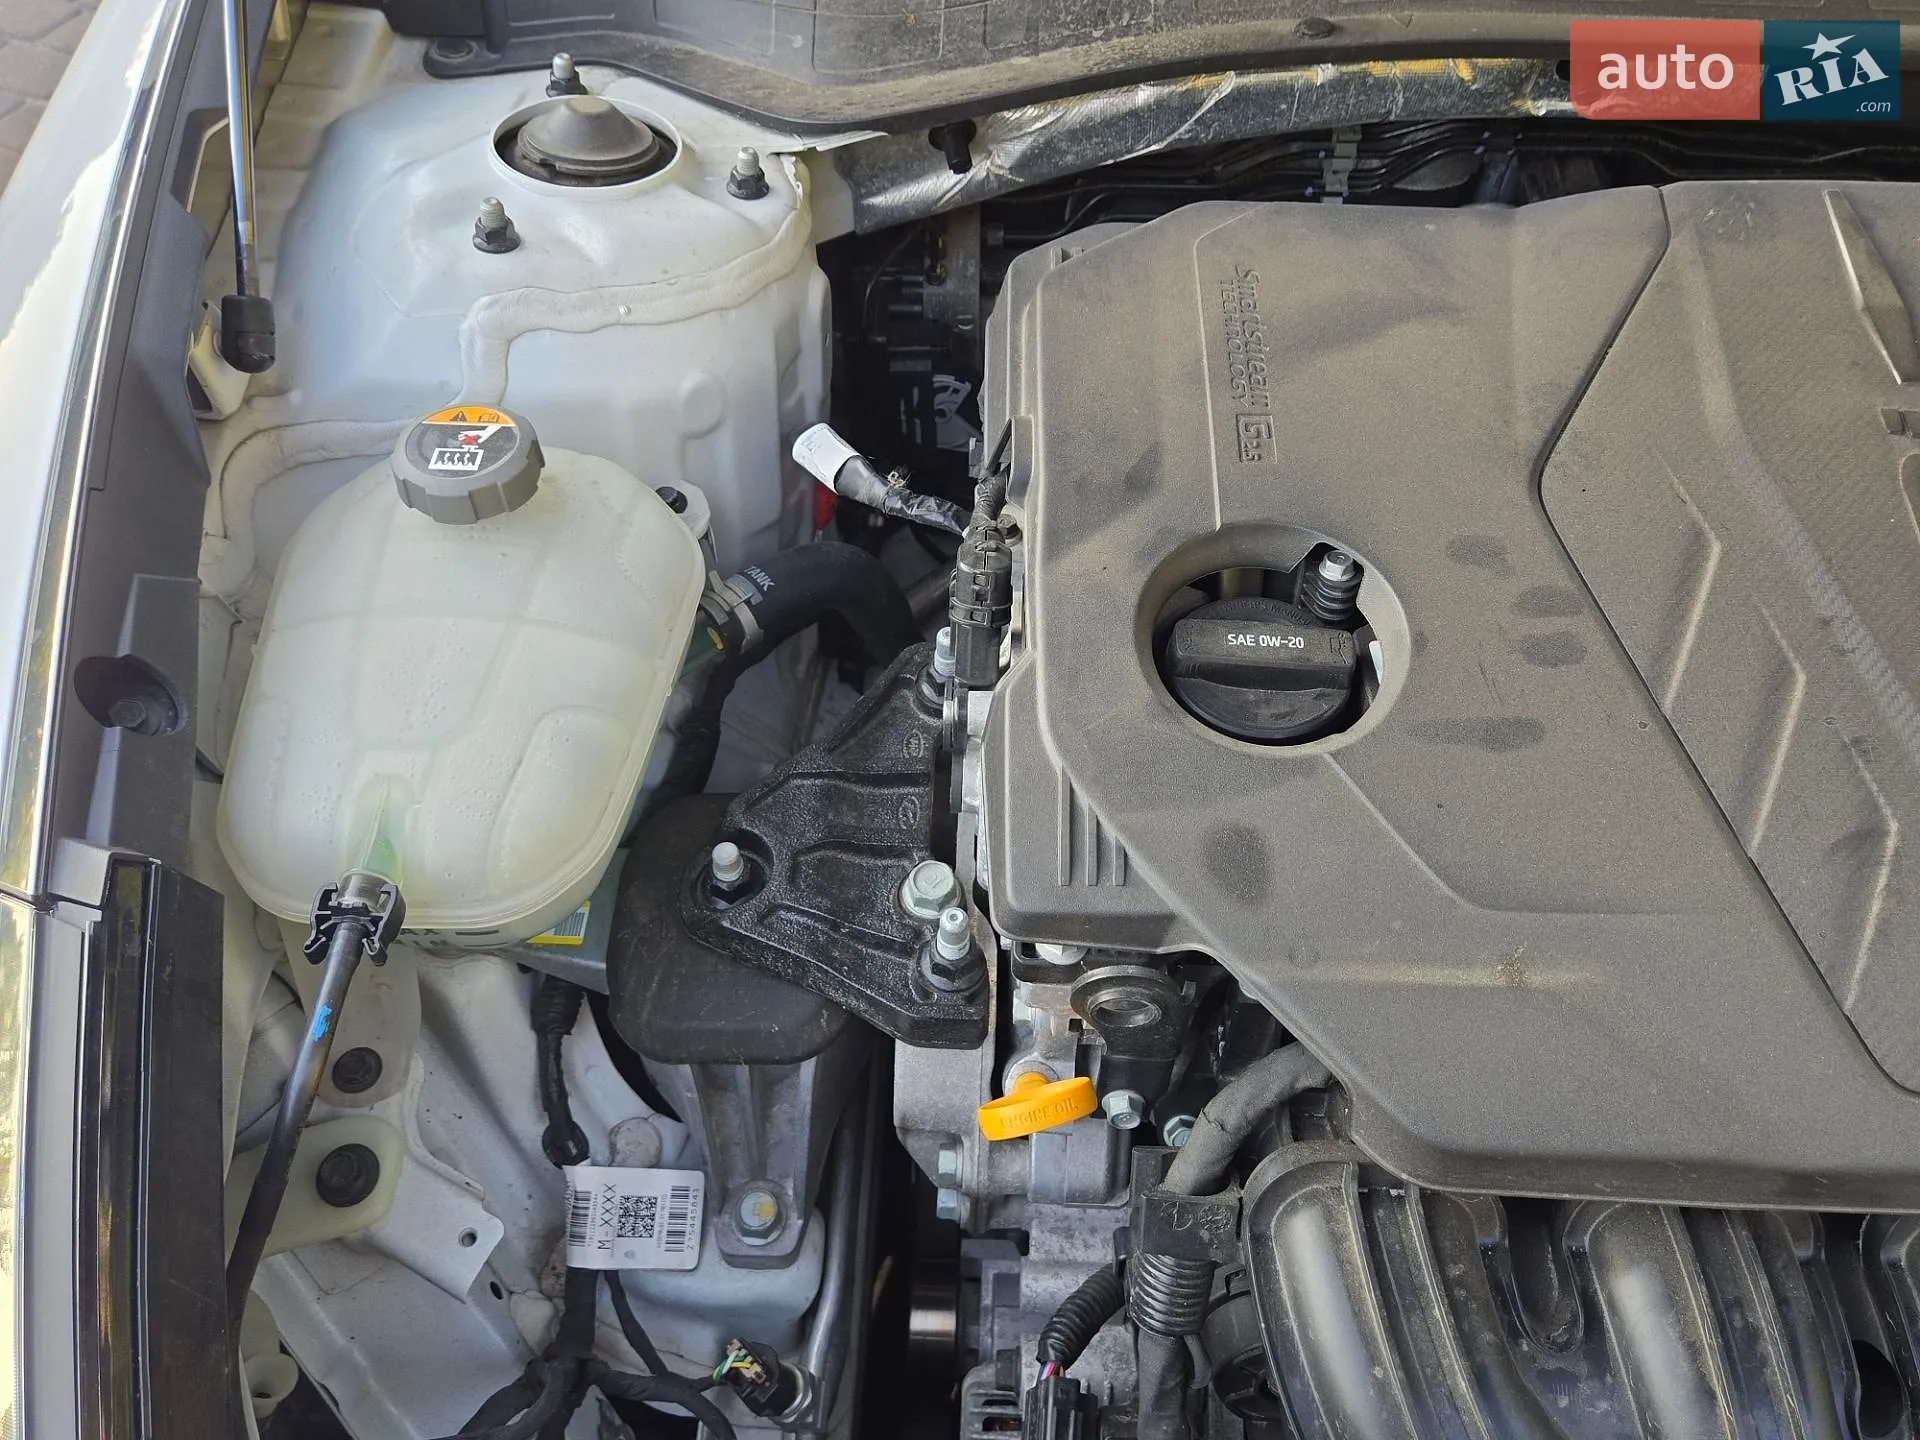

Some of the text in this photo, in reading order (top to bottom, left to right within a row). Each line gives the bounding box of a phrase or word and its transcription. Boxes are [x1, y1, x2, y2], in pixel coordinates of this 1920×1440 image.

[1220, 279, 1250, 409] TECHNOLOGY
[743, 566, 776, 592] TANK
[1227, 633, 1305, 649] SAE 0W-20
[1000, 1097, 1079, 1130] ENGINE OIL
[597, 1183, 617, 1250] M-XXXX
